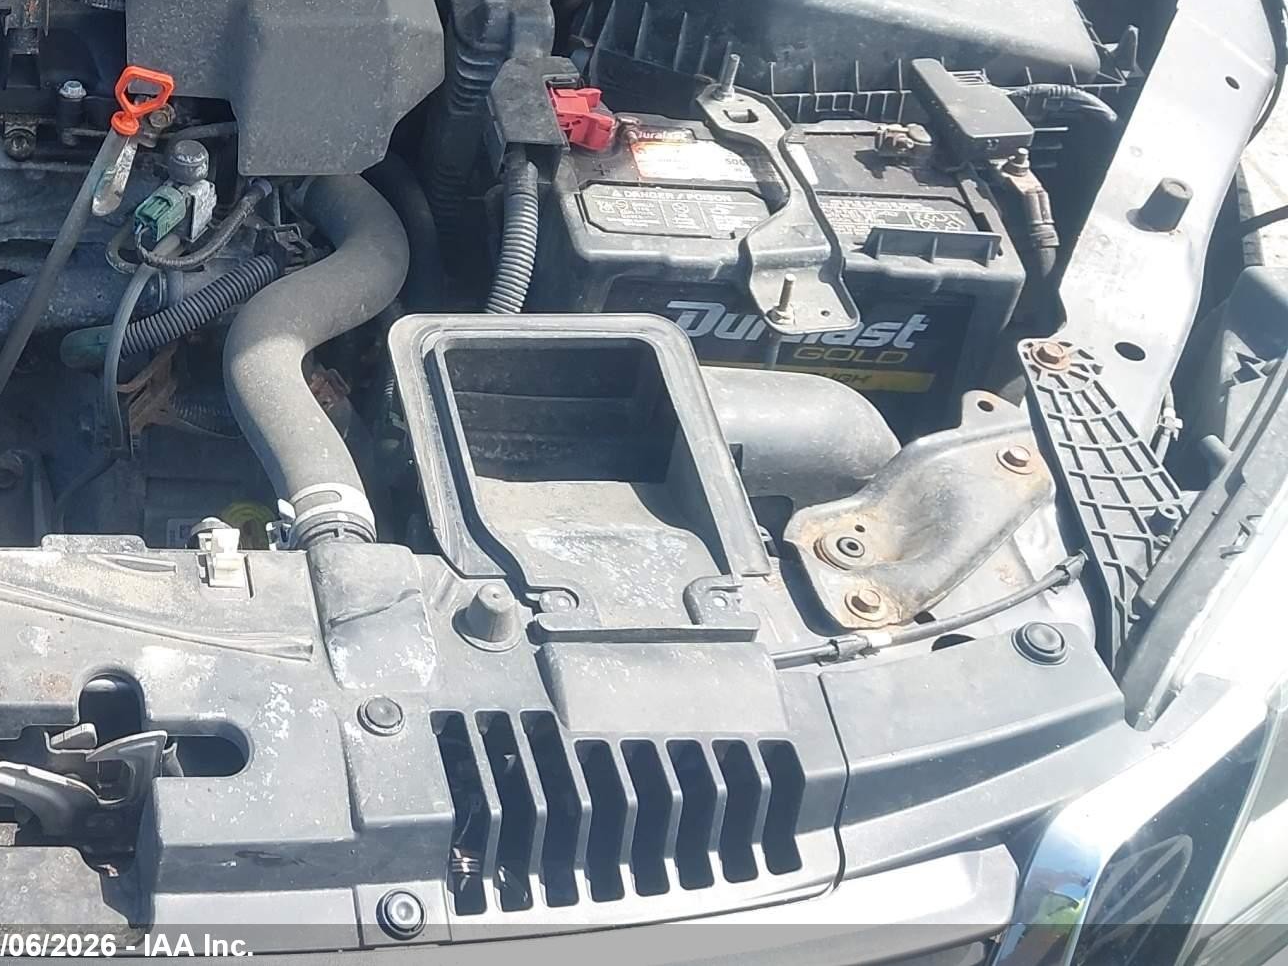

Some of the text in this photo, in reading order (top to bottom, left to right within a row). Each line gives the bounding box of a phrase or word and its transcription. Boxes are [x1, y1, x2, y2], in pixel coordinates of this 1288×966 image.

[624, 191, 676, 201] DANGER
[686, 192, 733, 203] POISON
[793, 347, 909, 365] GOLD
